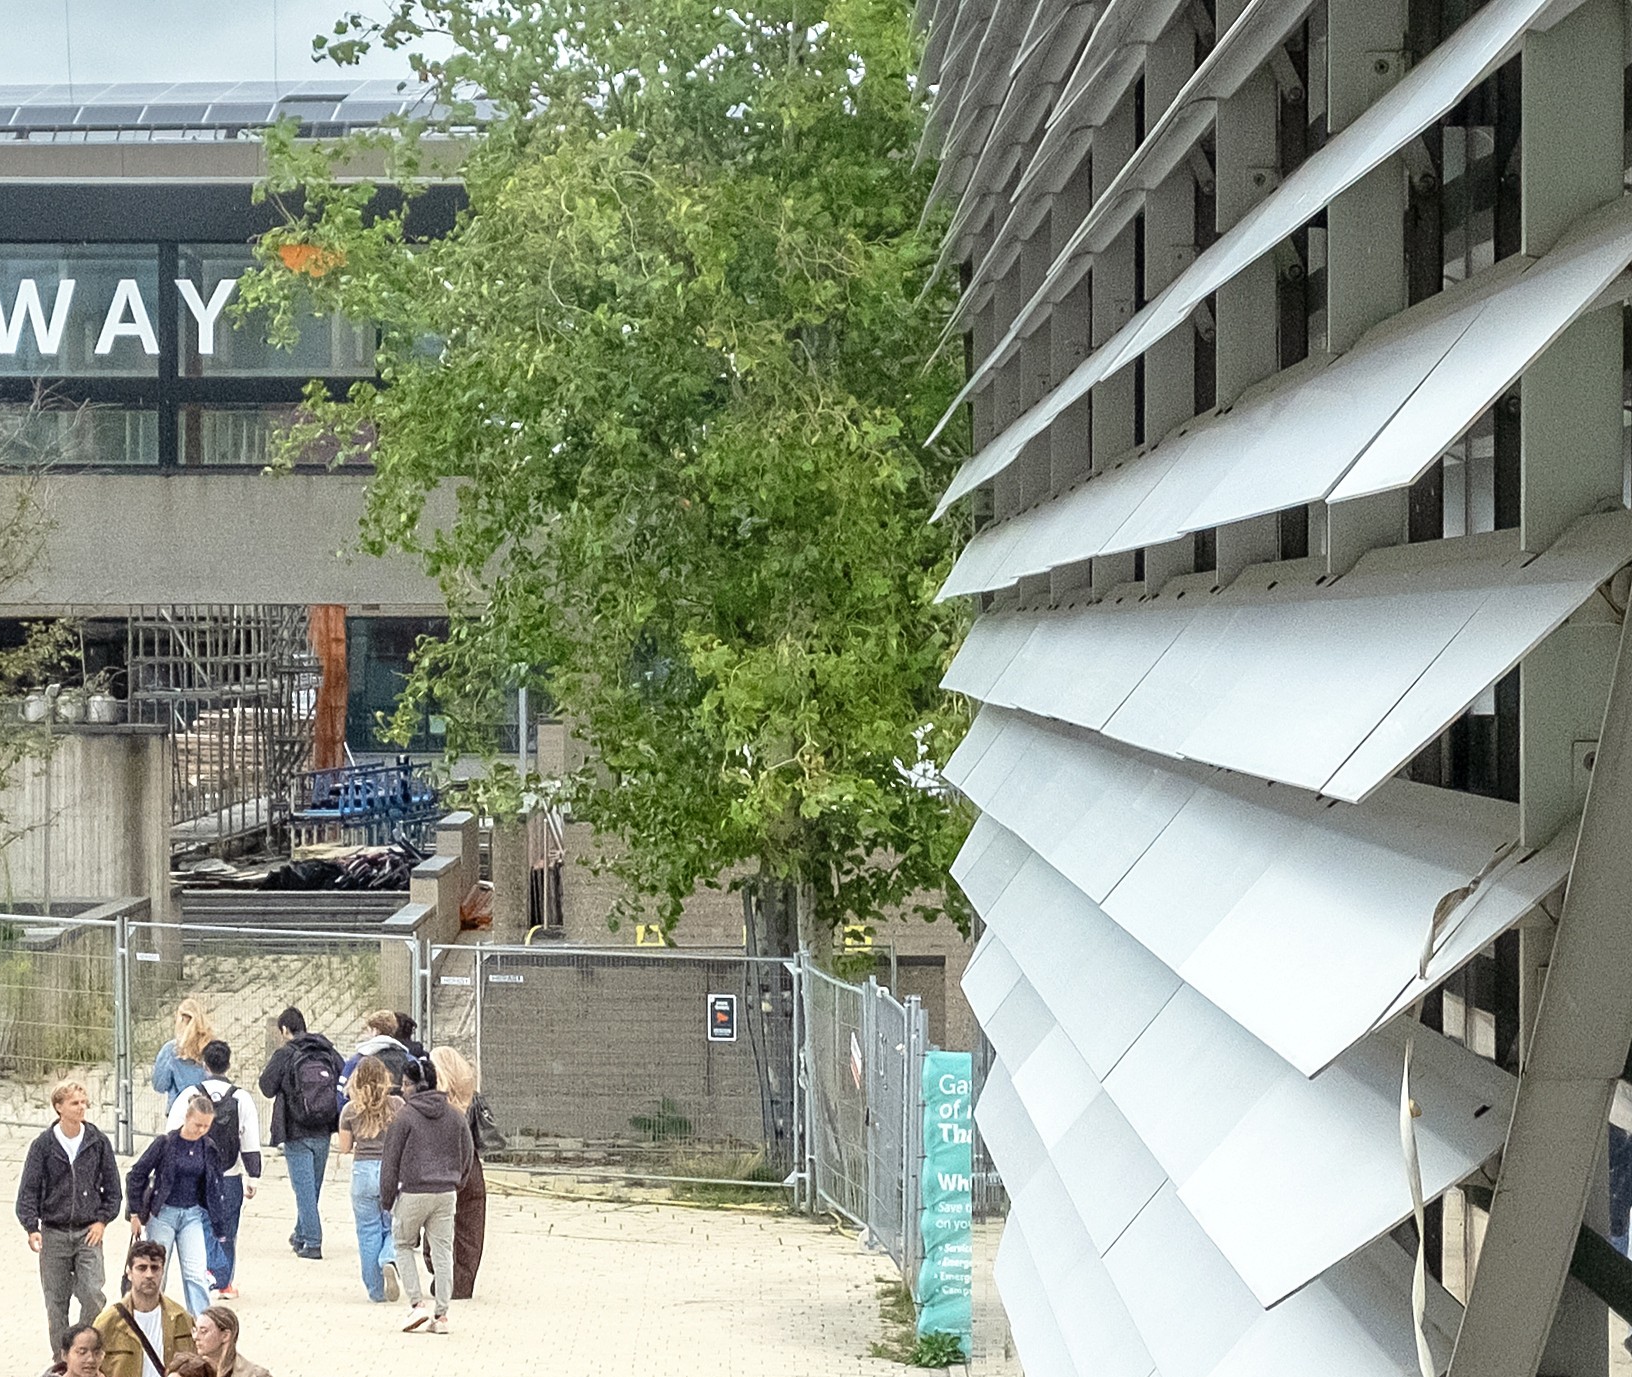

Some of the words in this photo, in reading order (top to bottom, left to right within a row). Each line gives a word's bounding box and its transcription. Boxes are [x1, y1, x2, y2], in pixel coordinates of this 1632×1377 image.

[940, 1099, 961, 1119] of
[937, 1172, 972, 1192] Wh
[938, 1202, 963, 1213] Save
[935, 1219, 951, 1229] on
